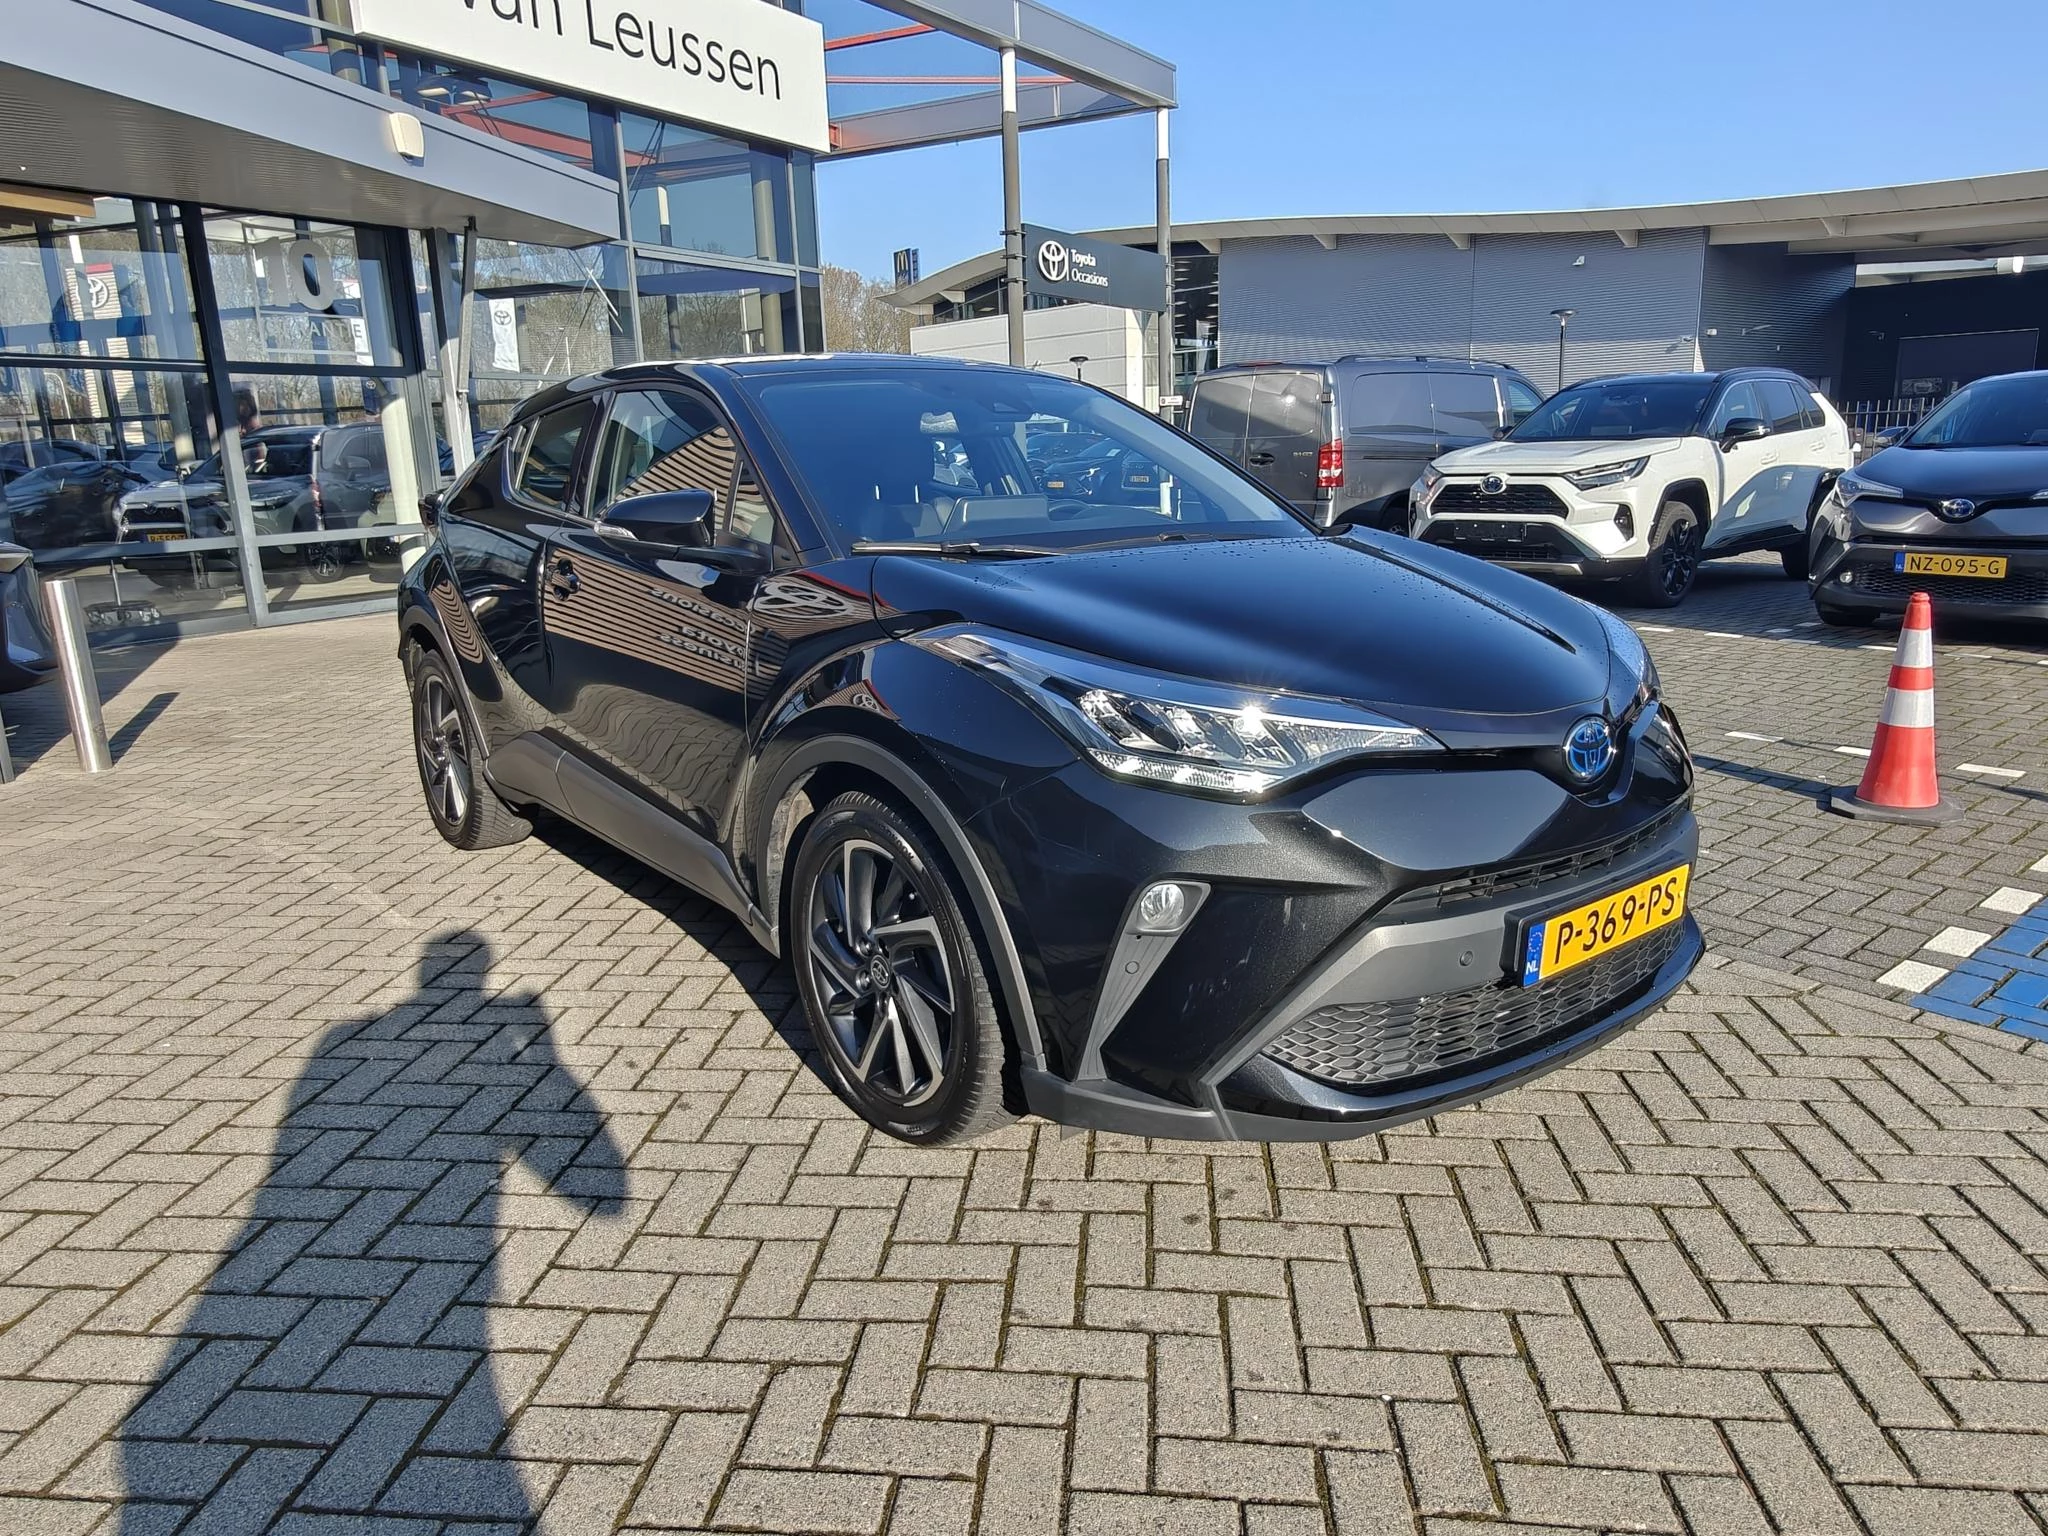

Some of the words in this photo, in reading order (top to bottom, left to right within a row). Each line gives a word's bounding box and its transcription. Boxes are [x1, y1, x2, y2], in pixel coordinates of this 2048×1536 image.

[585, 0, 782, 100] Leussen
[255, 236, 336, 311] 10
[1070, 248, 1097, 268] Toyota
[1071, 268, 1109, 288] Occasions
[1909, 555, 2000, 576] NZ-095-G
[1526, 960, 1539, 975] NL
[1554, 876, 1678, 965] P-369-PS
